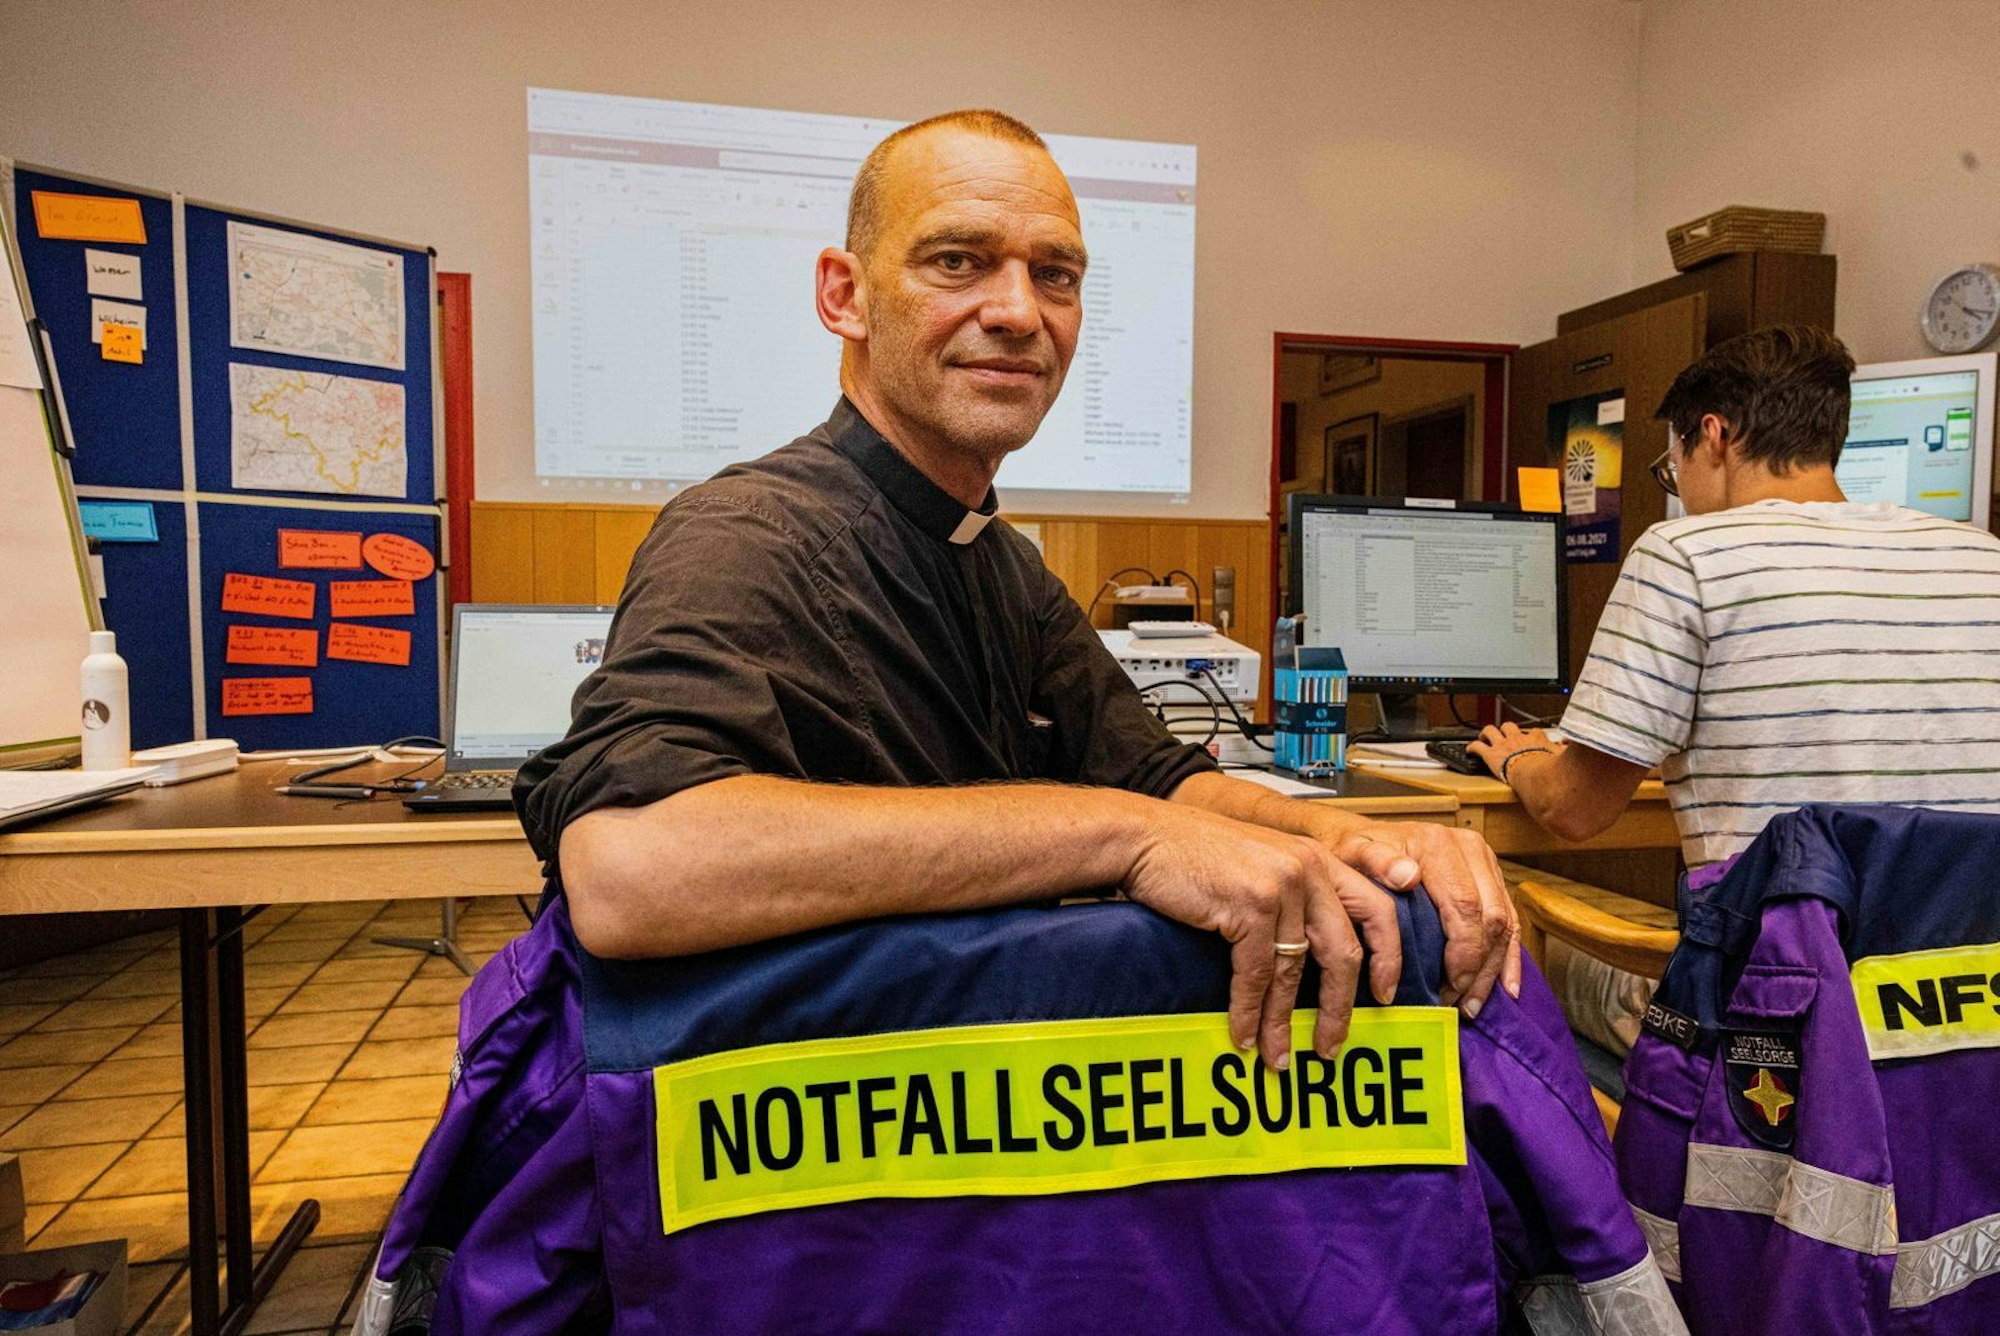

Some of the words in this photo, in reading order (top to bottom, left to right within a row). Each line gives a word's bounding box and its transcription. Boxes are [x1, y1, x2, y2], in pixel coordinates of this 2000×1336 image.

[1305, 720, 1336, 728] Schneider
[1877, 971, 2000, 1031] NF
[1641, 1004, 1688, 1039] EBKE
[1730, 1046, 1796, 1064] SEELSORGE
[1733, 1035, 1786, 1050] NOTFALL
[698, 1046, 1428, 1182] NOTFALLSEELSORGE
